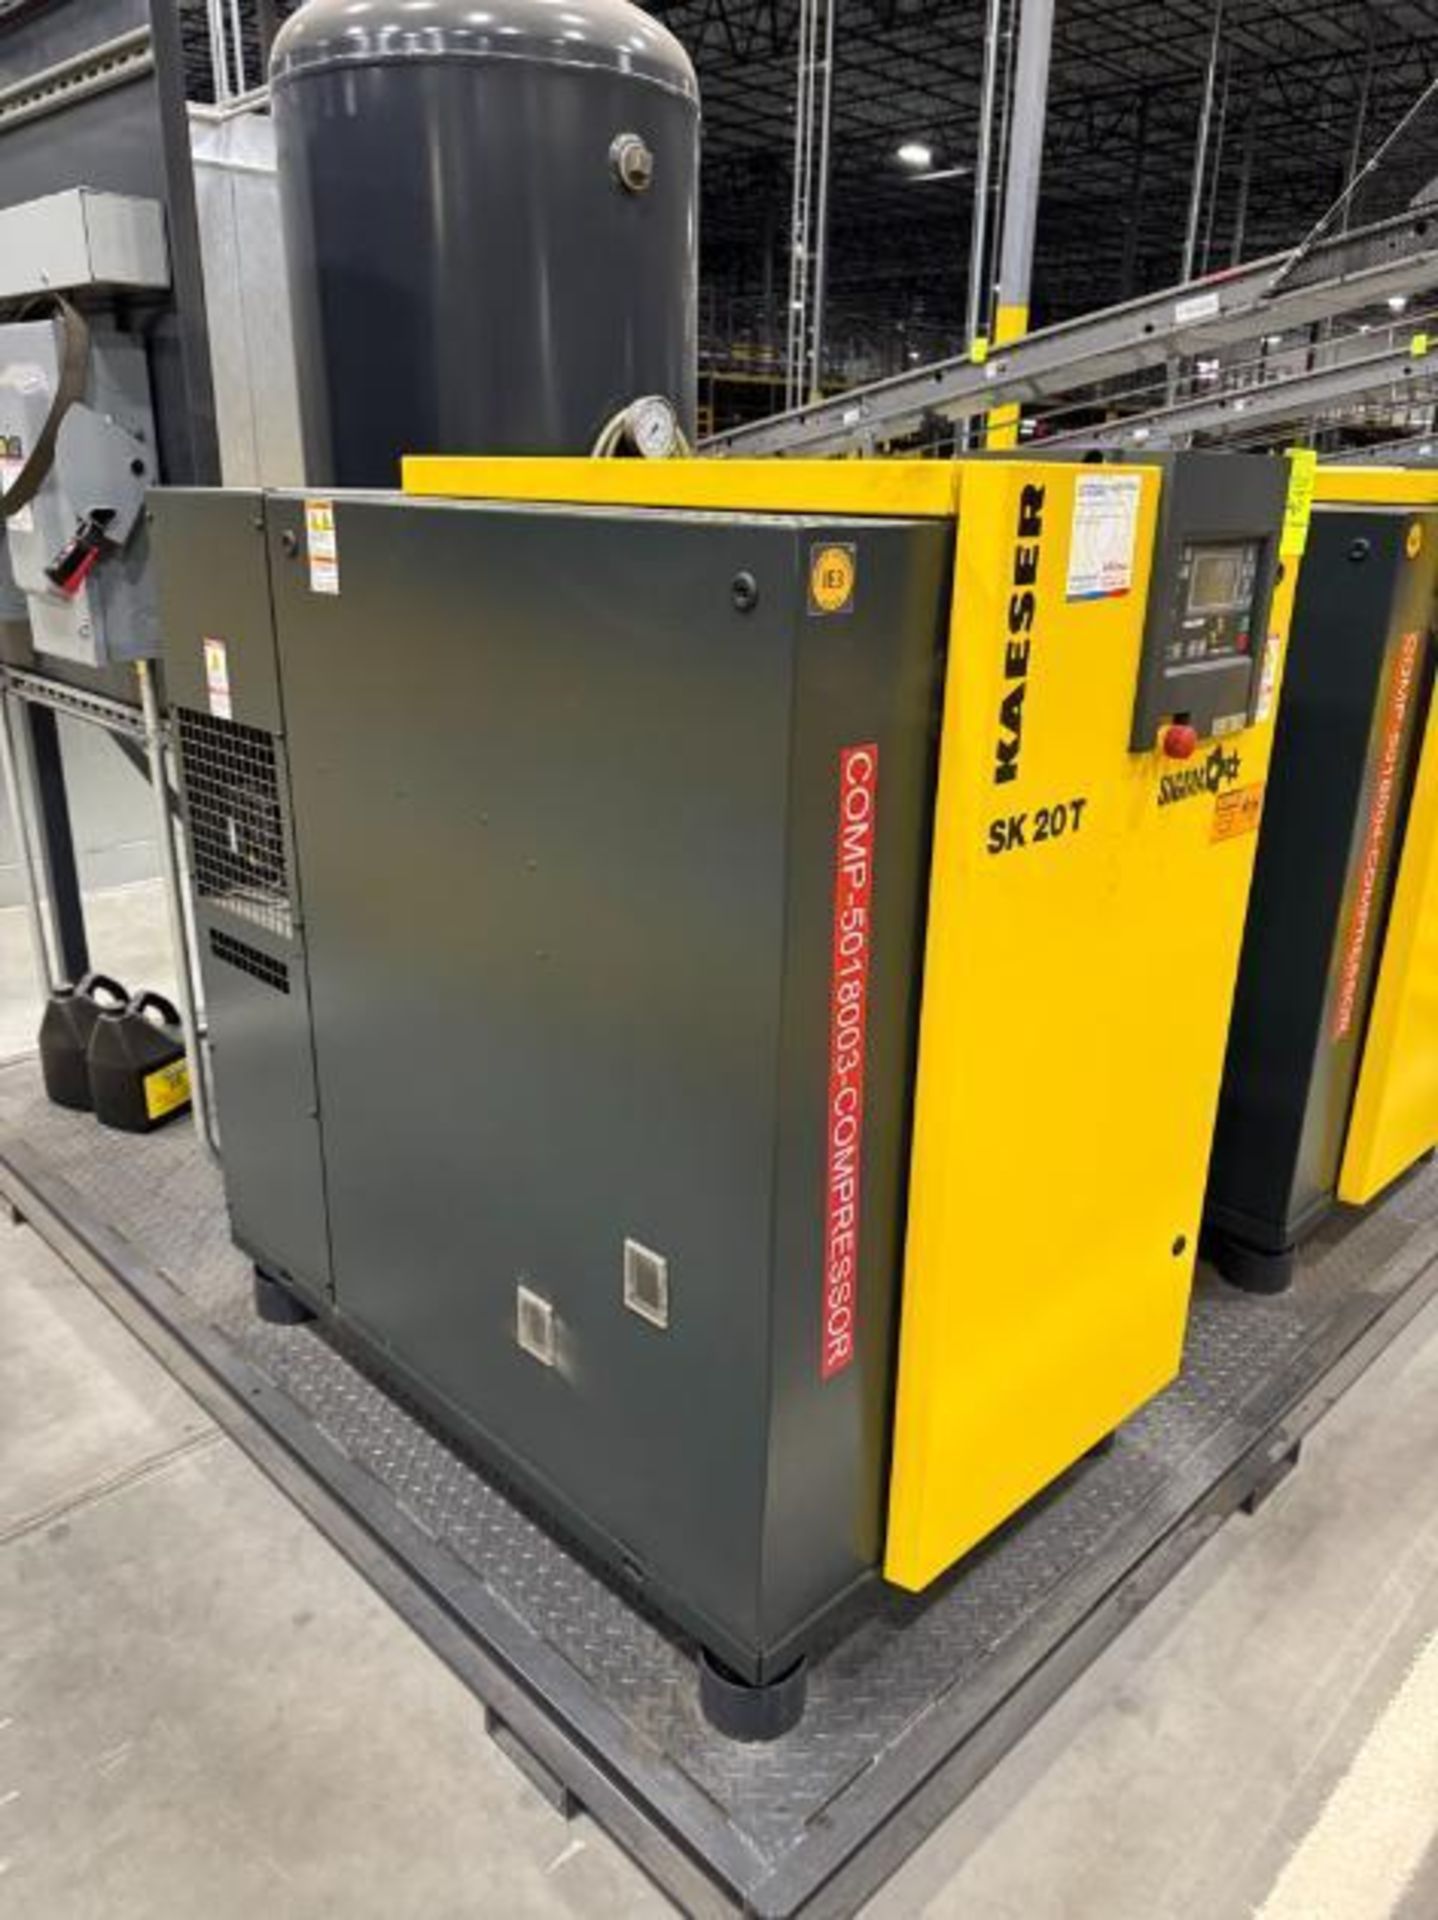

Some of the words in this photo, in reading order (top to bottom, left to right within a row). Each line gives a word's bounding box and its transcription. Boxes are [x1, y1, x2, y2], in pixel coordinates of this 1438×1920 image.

[822, 569, 845, 590] IE3
[994, 484, 1045, 785] KAESER
[987, 812, 1028, 855] SK
[827, 751, 872, 1367] COMP-5018003-COMPRESSOR
